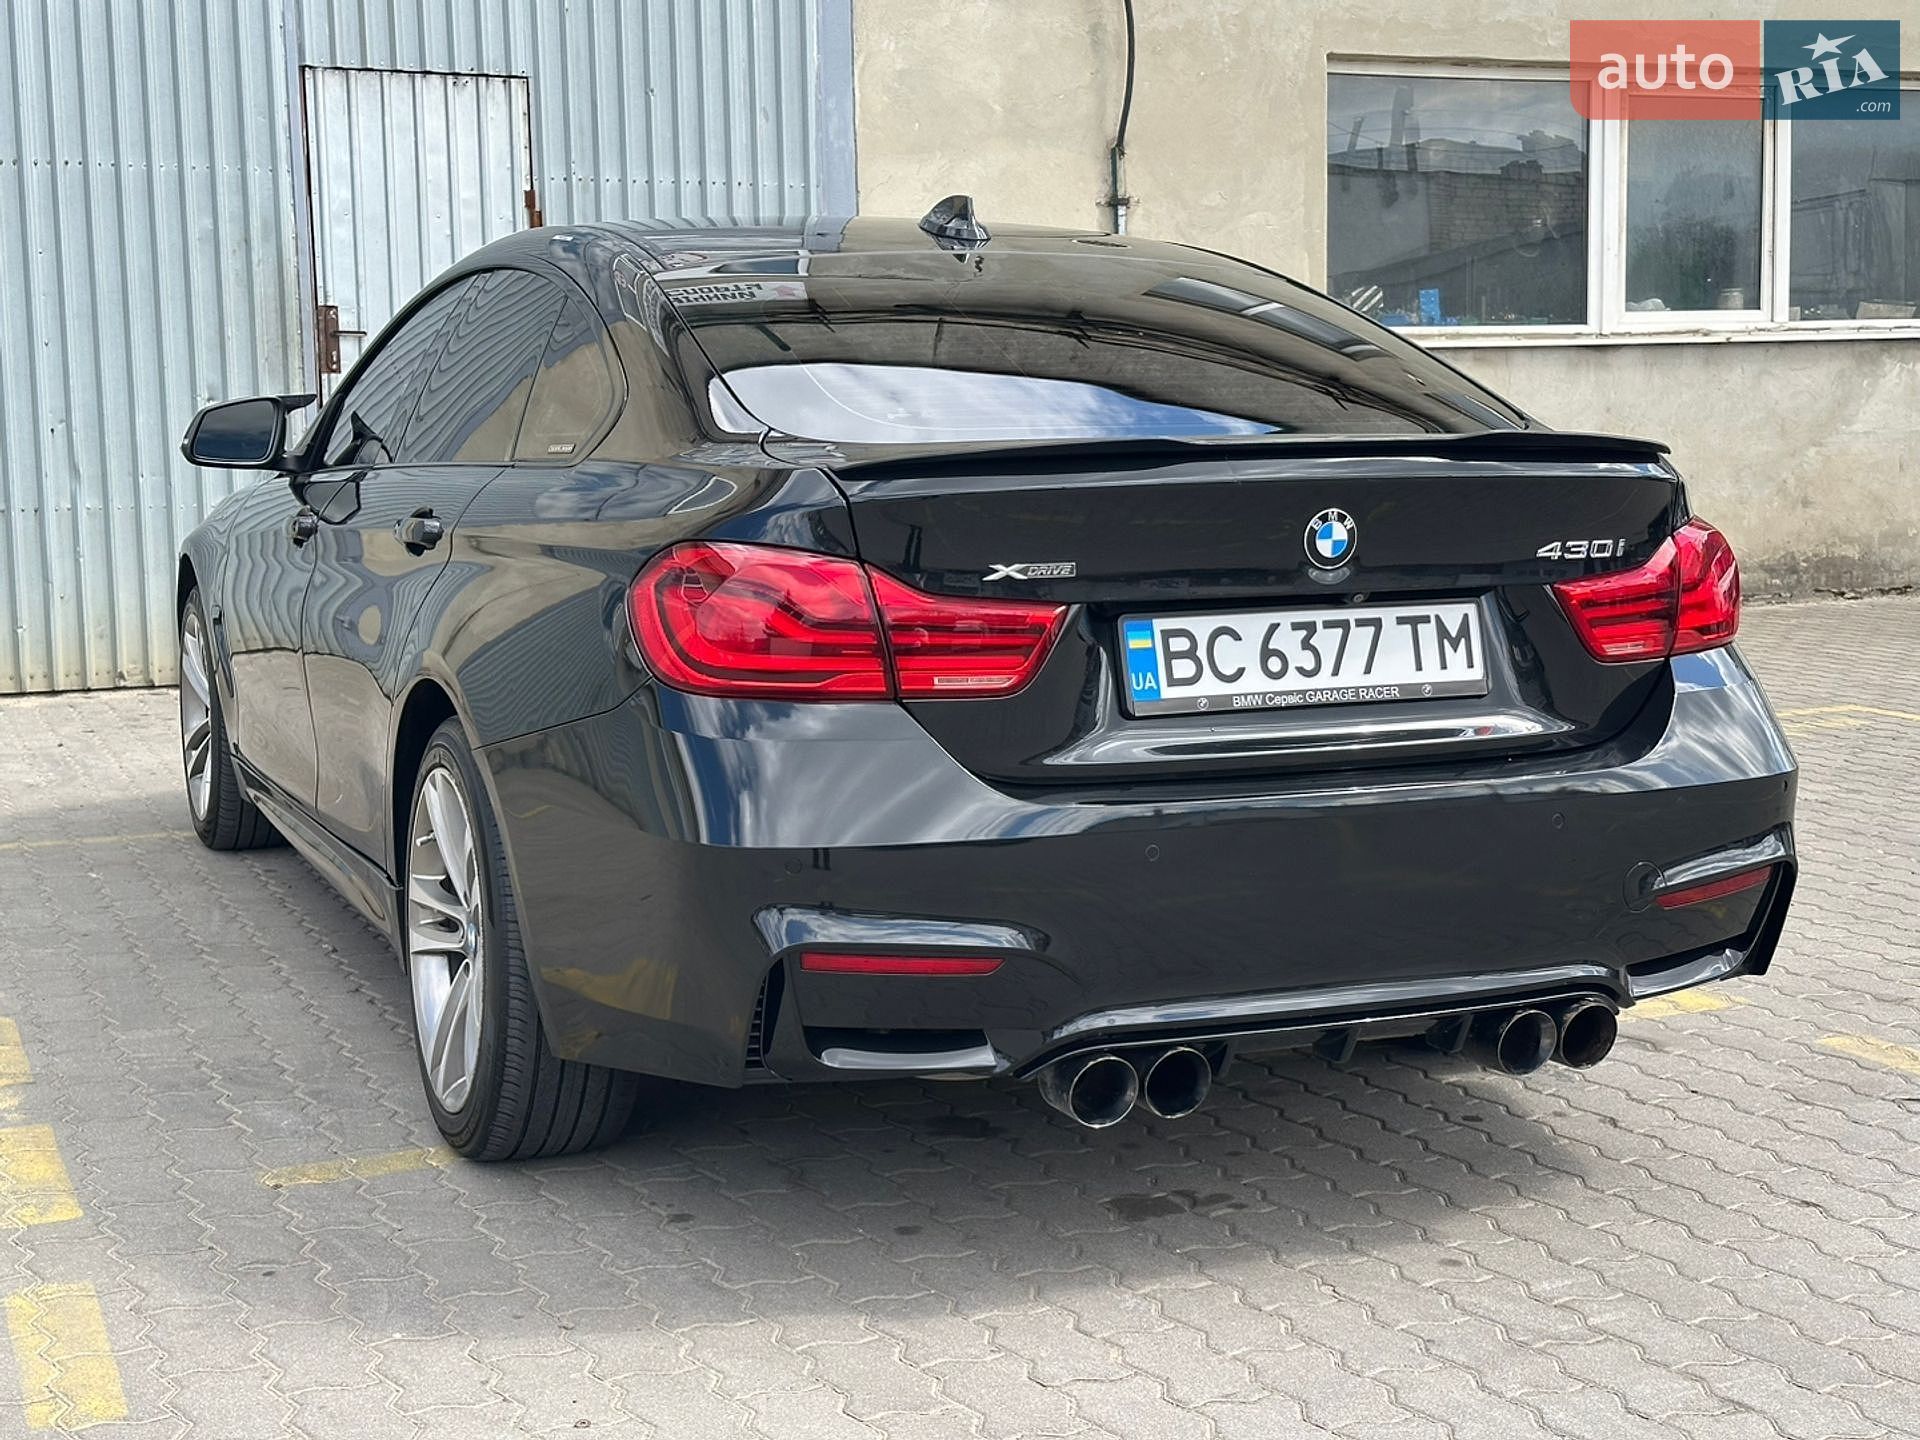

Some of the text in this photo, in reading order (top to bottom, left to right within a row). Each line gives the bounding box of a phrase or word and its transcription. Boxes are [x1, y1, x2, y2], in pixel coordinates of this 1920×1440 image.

[1310, 511, 1355, 530] BMW
[1536, 539, 1626, 560] 430i
[1160, 612, 1475, 688] BC 6377 TM
[1131, 674, 1158, 691] UA
[1232, 694, 1263, 707] BMW
[1306, 688, 1356, 702] GARAGE
[1358, 686, 1400, 700] RACER
